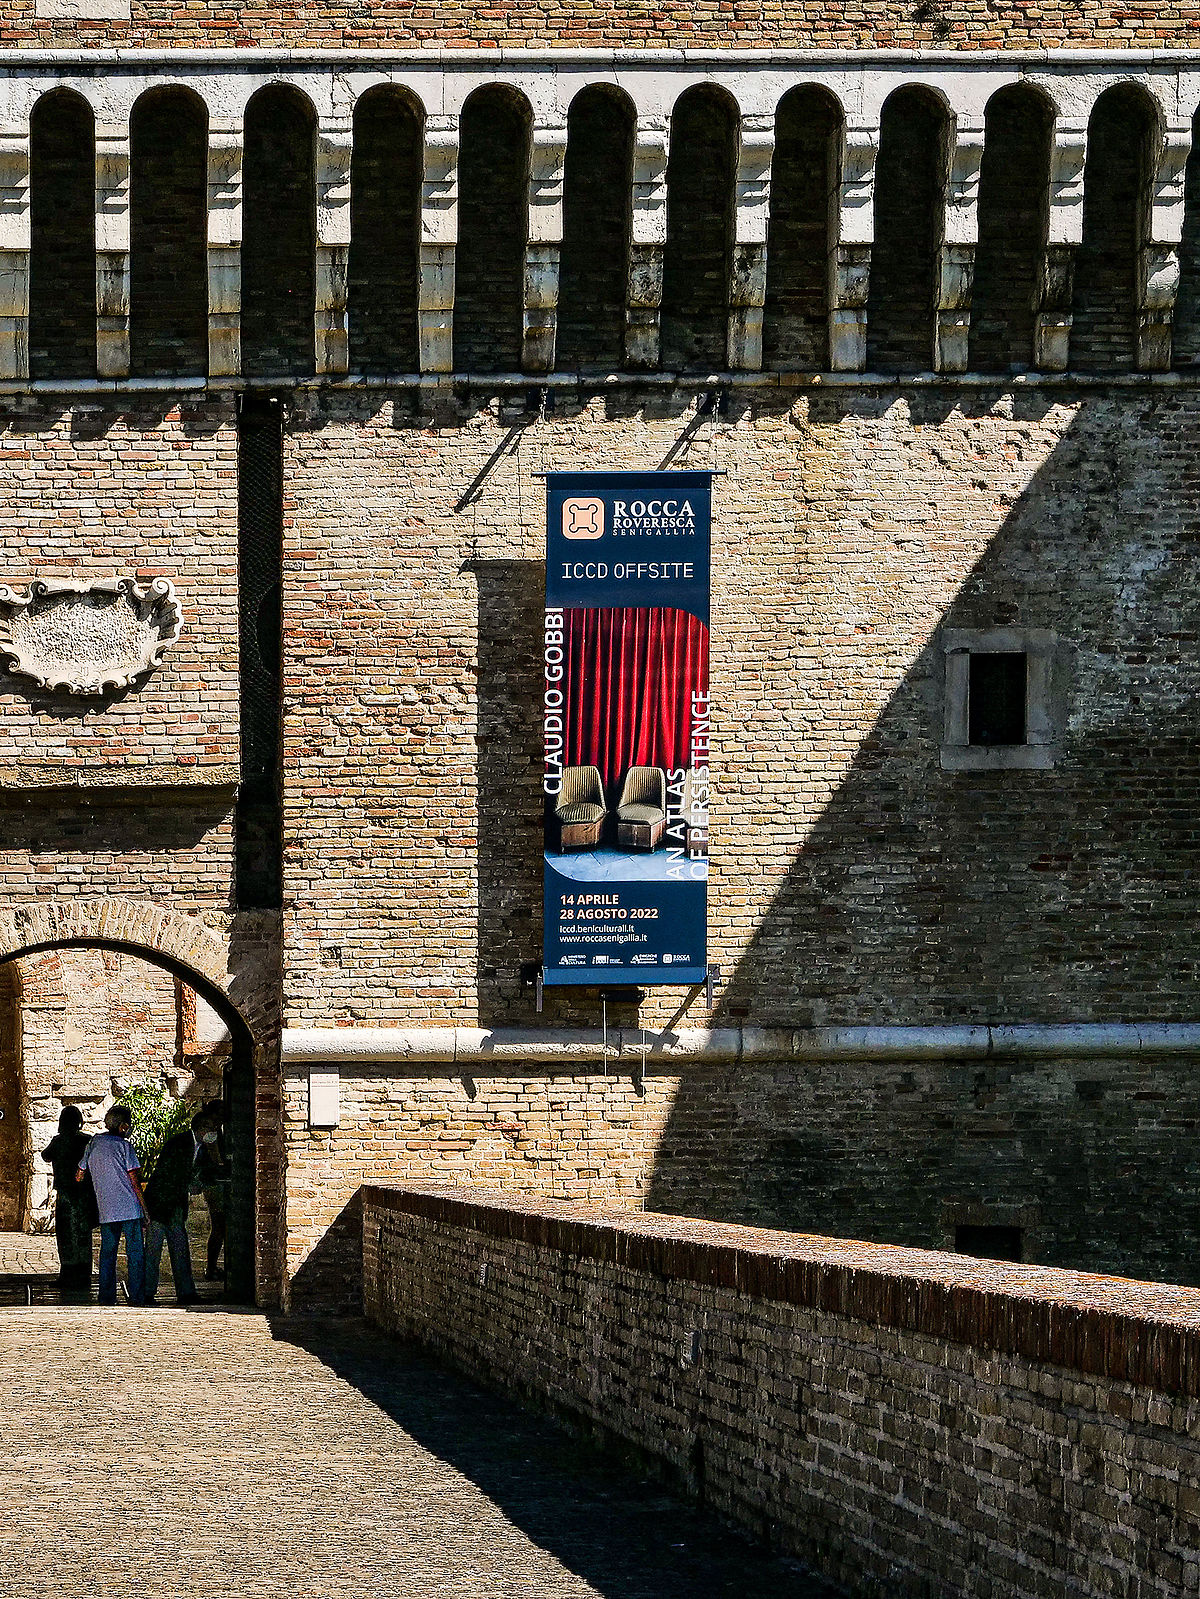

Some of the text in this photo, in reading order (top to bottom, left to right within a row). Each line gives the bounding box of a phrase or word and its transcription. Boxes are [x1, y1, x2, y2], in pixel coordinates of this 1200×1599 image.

[613, 500, 695, 517] ROCCA
[613, 518, 695, 528] ROVERESCA
[613, 528, 695, 536] SENIGALLIA
[561, 562, 694, 579] ICCD OFFSITE
[543, 607, 564, 795] CLAUDIO GOBBI
[690, 690, 711, 880] OF PERSISTENCE
[666, 768, 687, 880] AN ATLAS
[560, 894, 619, 905] 14 APRILE
[560, 908, 659, 920] 28 AGOSTO 2022
[559, 924, 635, 933] iccd.beniculturali.it
[559, 934, 648, 944] www.roccasenigallia.it
